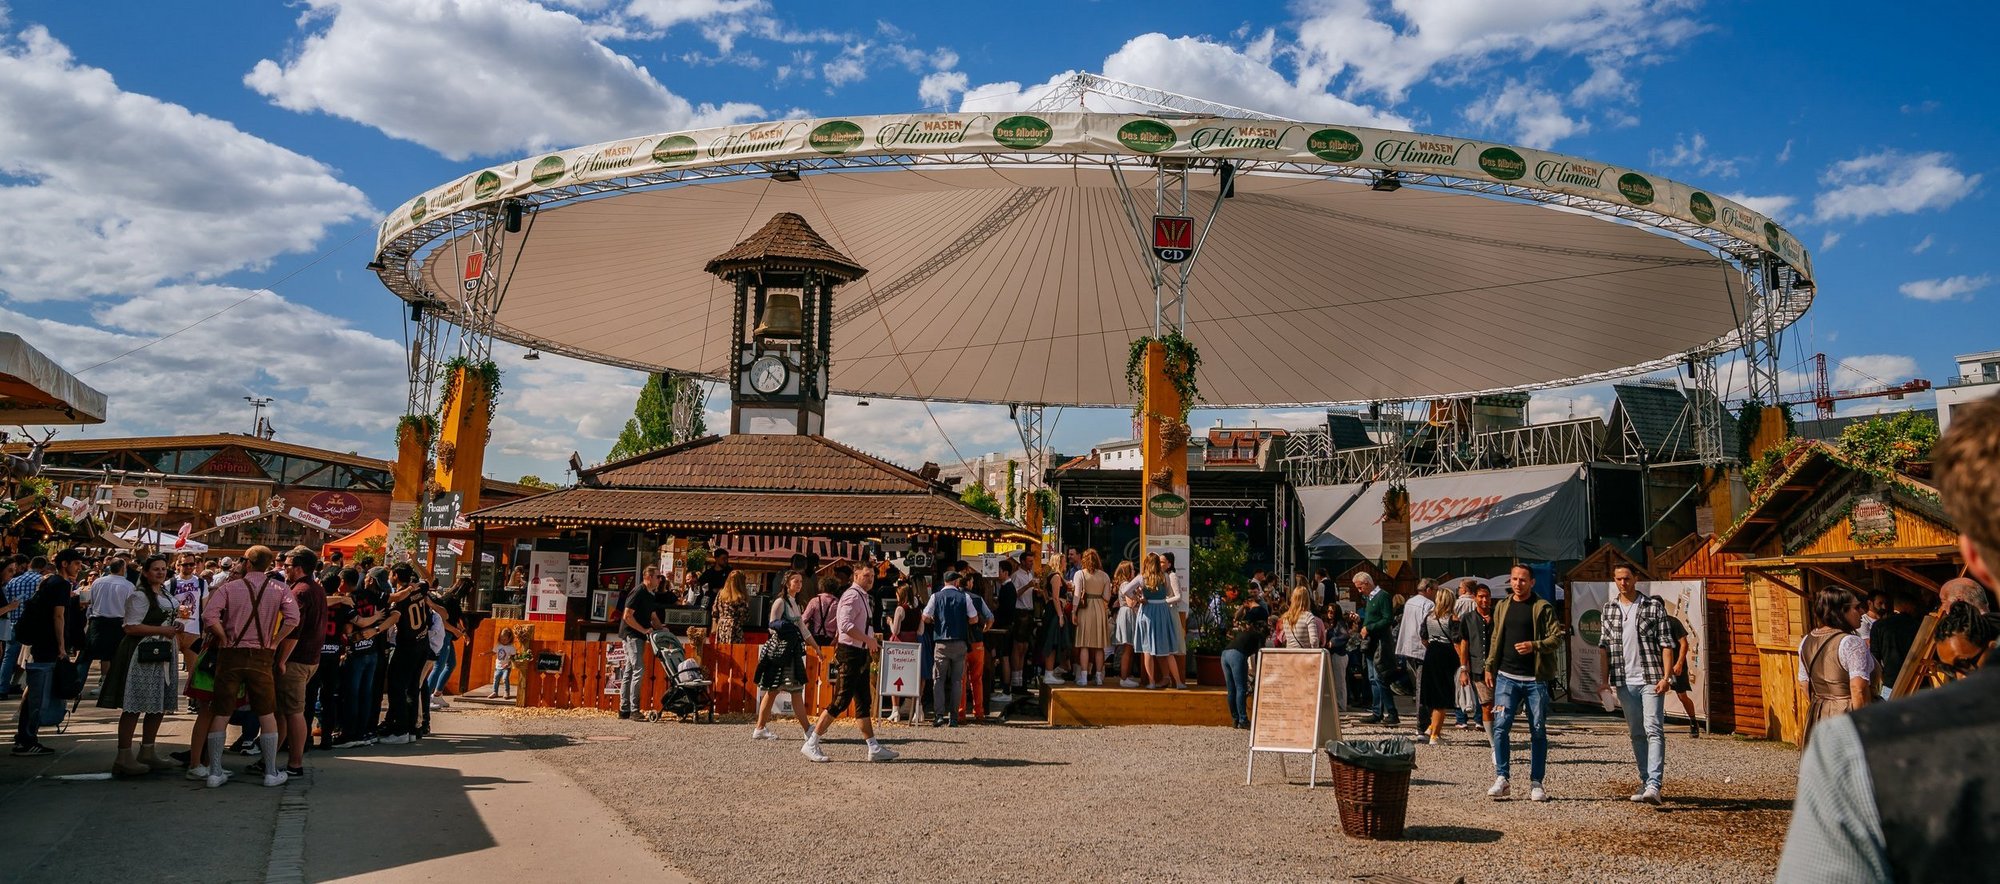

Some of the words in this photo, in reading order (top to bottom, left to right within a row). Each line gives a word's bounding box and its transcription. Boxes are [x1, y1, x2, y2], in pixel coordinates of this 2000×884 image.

[924, 120, 962, 131] WASEN
[750, 129, 783, 141] WASEN
[813, 133, 828, 143] Das
[830, 131, 862, 142] Albdorf
[874, 114, 991, 152] Himmel
[997, 127, 1014, 137] Das
[1015, 127, 1049, 138] Albdorf
[1120, 131, 1138, 140] Das
[1140, 131, 1173, 142] Albdorf
[1239, 127, 1277, 138] WASEN
[707, 122, 808, 163] Himmel
[1189, 125, 1305, 154] Himmel
[1310, 139, 1326, 149] Das
[1329, 140, 1359, 151] Albdorf
[604, 146, 632, 158] WASEN
[1372, 138, 1476, 167] Himmel
[1419, 141, 1453, 153] WASEN
[571, 138, 652, 181] Himmel
[1481, 157, 1496, 167] Das
[1498, 158, 1524, 171] Albdorf
[1534, 159, 1616, 188] Himmel
[1571, 163, 1597, 176] WASEN
[1161, 249, 1184, 260] CD
[466, 279, 477, 290] CD
[116, 498, 164, 511] Dorfplatz
[1162, 501, 1185, 509] Albdorf
[1855, 503, 1886, 517] Pommes
[298, 510, 322, 525] Hofbräu
